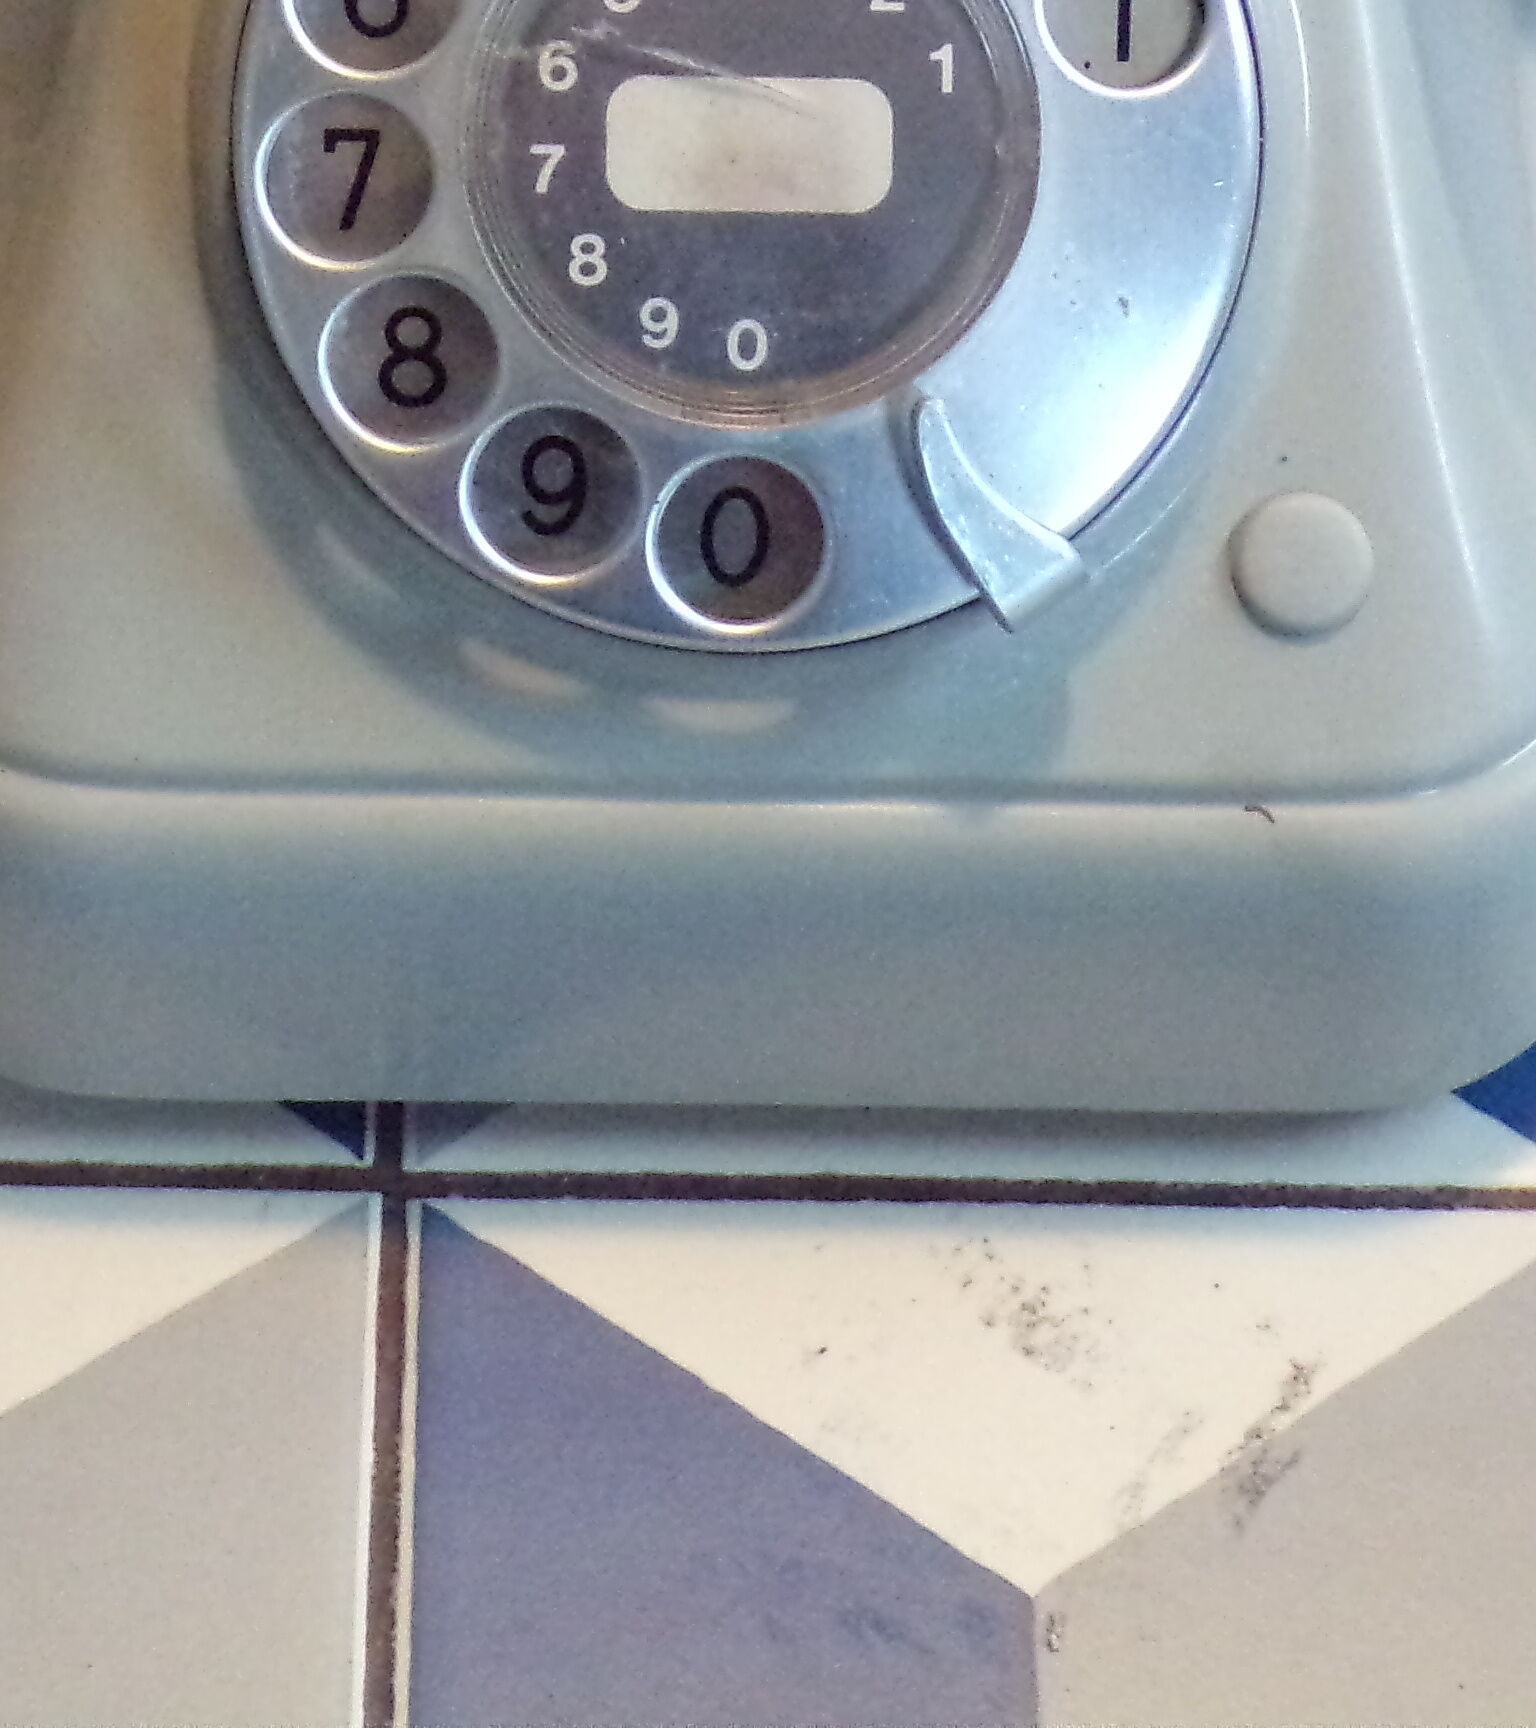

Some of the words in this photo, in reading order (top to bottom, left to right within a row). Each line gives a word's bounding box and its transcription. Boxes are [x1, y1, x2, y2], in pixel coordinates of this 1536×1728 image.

[539, 44, 578, 91] 6
[929, 44, 955, 91] 1
[530, 146, 565, 193] 7
[568, 236, 607, 285] 8
[639, 298, 678, 346] 9
[726, 319, 767, 369] 0
[323, 128, 380, 230] 7
[379, 307, 446, 407] 8
[521, 435, 587, 535] 9
[699, 486, 768, 587] 0
